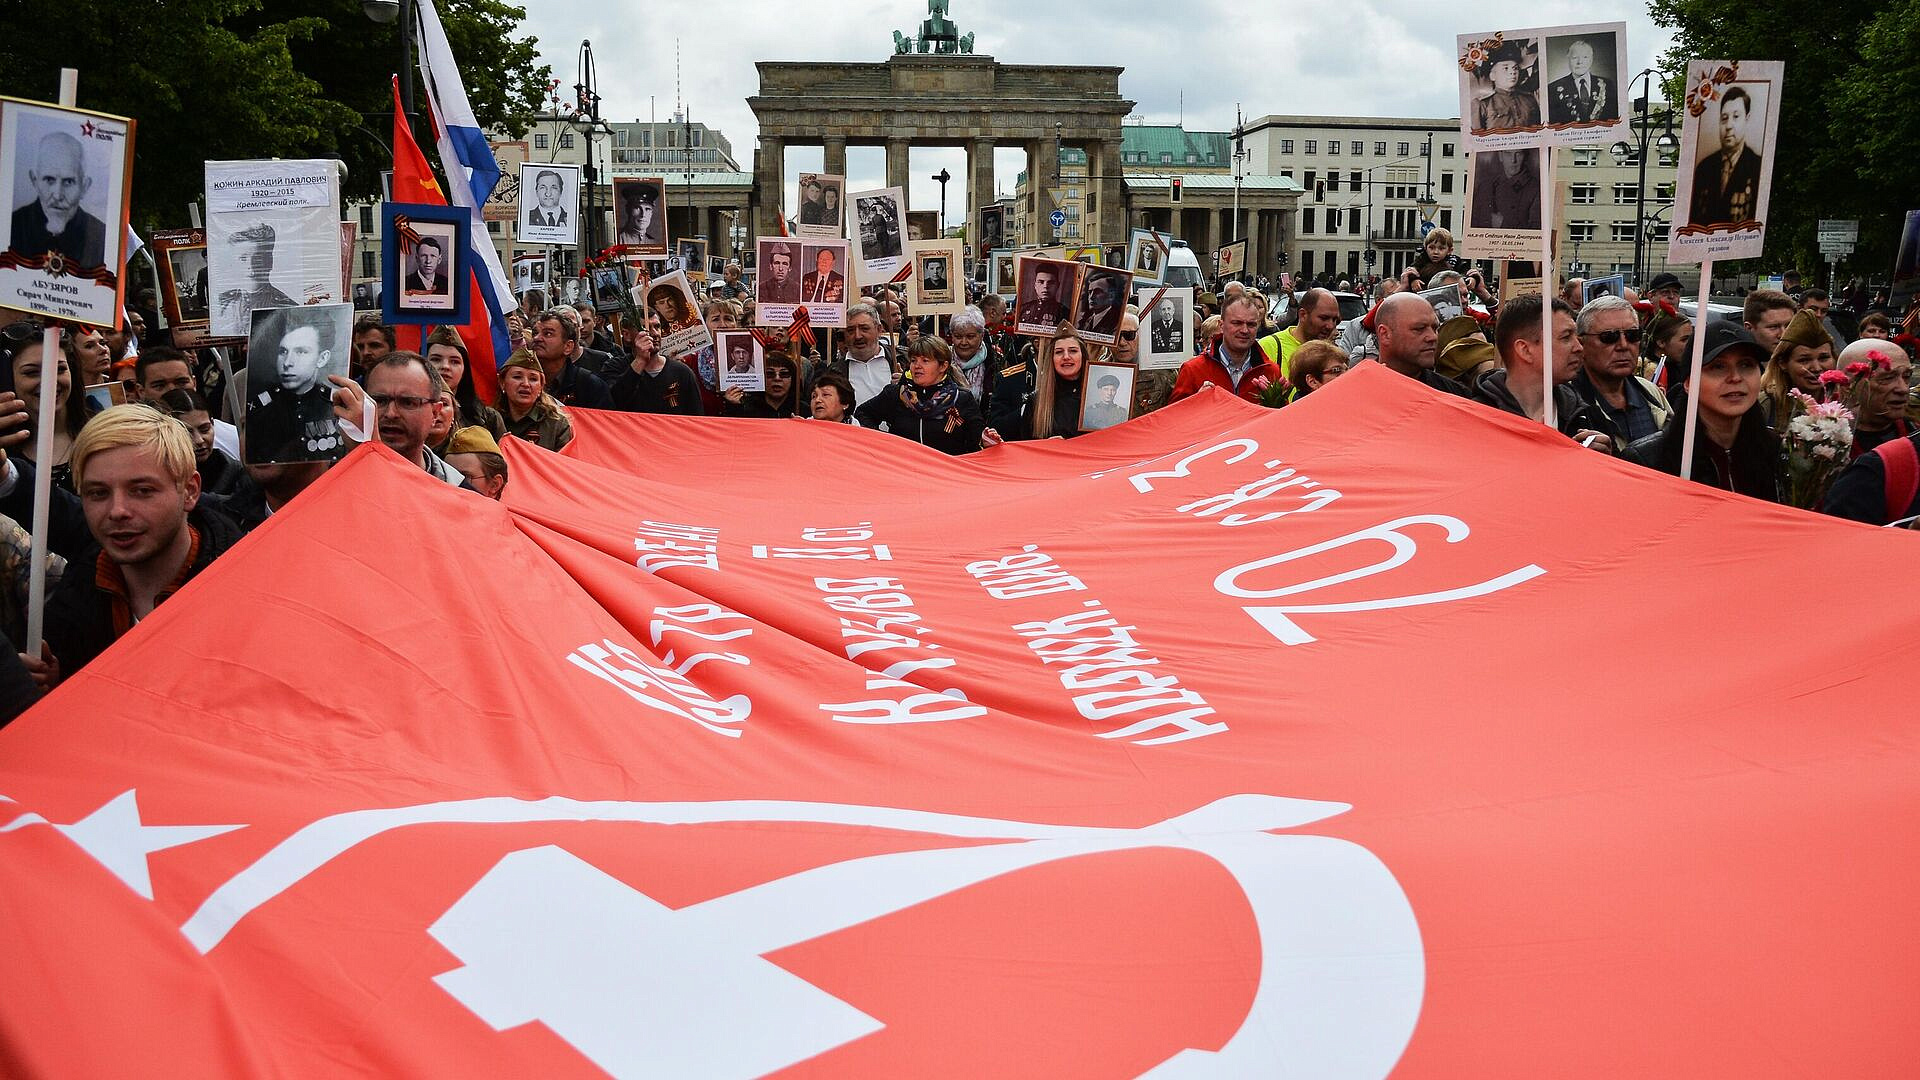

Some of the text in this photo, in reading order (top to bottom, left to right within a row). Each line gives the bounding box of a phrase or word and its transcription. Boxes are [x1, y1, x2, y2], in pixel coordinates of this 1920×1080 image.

[214, 175, 327, 189] КОЖИН АРКАДИЙ ПАВЛОВИЧ
[251, 189, 269, 197] 1920
[32, 280, 78, 295] АБУЗЯРОВ
[1214, 514, 1548, 646] 79
